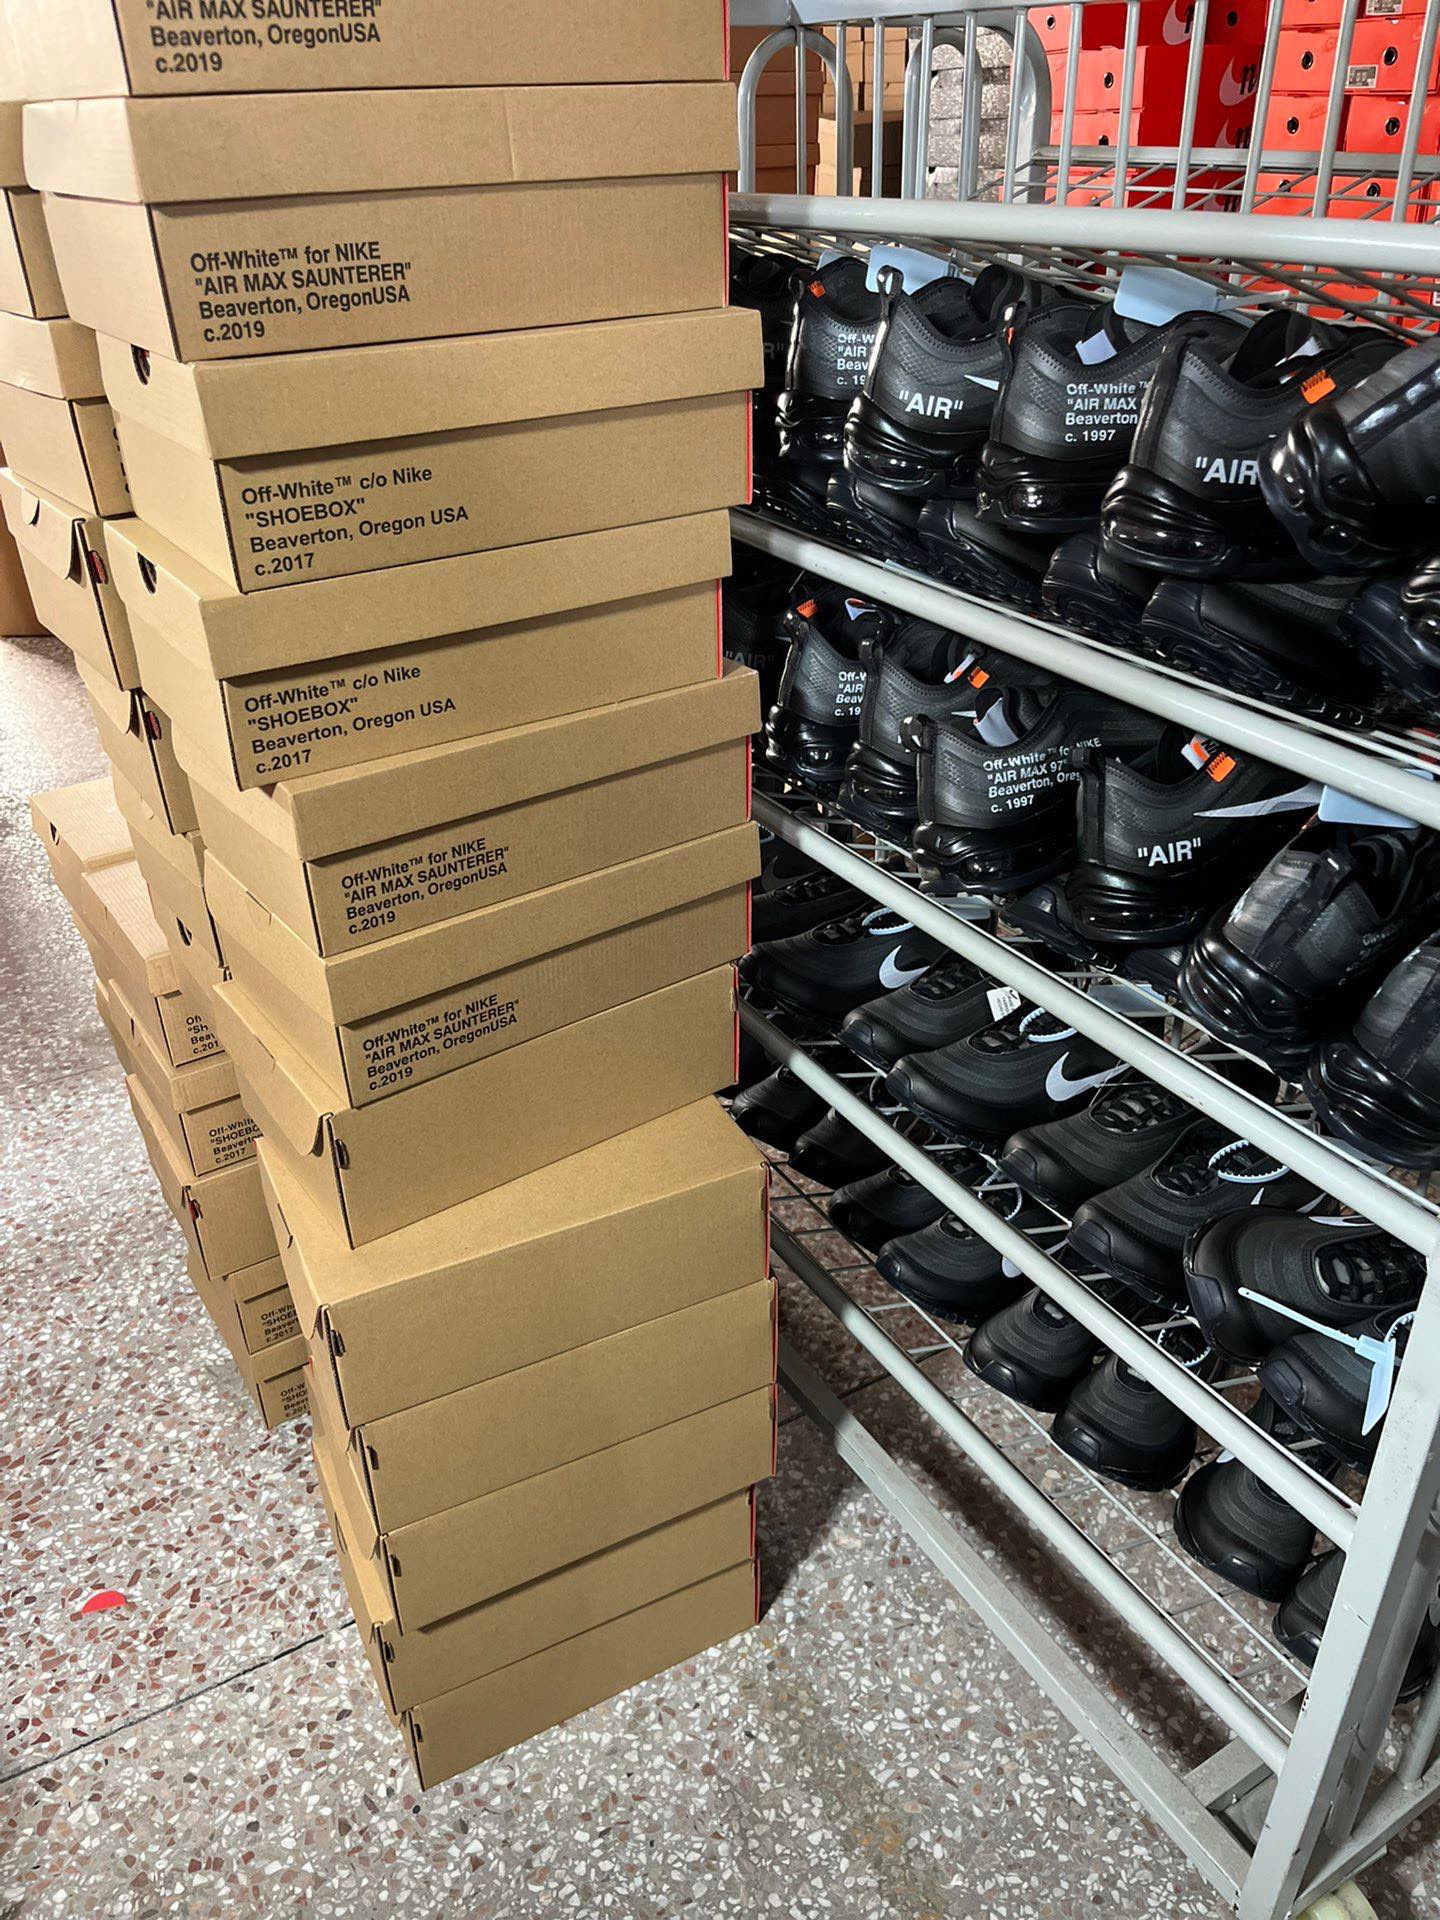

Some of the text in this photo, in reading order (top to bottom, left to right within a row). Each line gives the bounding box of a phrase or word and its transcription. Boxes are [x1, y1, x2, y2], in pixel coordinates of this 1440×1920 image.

[147, 0, 193, 20] "AIR
[200, 0, 247, 19] MAX
[150, 22, 381, 49] Beaverton, OregonUSA
[155, 52, 223, 73] c.2019
[190, 241, 381, 273] Off-White™ for NIKE
[195, 262, 412, 296] "AIR MAX SAUNTERER"
[199, 284, 410, 320] Beaverton, OregonUSA
[203, 320, 265, 342] c.2019
[837, 377, 848, 385] c.
[899, 390, 964, 420] "AIR"
[1065, 412, 1138, 425] Beaverton
[1067, 397, 1137, 411] "AIR MAX
[1065, 429, 1116, 442] c. 1997
[1195, 456, 1259, 485] "AIR
[241, 467, 432, 505] Off-White™ c/o Nike
[245, 498, 365, 528] "SHOEBOX"
[250, 506, 469, 553] Beaverton, Oregon USA
[254, 552, 314, 576] c.2017
[244, 667, 421, 713] Off-White™ c/o Nike
[248, 697, 358, 731] "SHOEBOX"
[252, 698, 456, 754] Beaverton, Oregon USA
[256, 749, 312, 774] c.2017
[987, 770, 1017, 785] "AIR
[1020, 763, 1048, 779] MAX
[988, 776, 1054, 799] Beaverton,
[990, 794, 1035, 813] c. 1997
[342, 838, 487, 889] Off-White™ for NIKE
[1137, 837, 1201, 867] "AIR"
[344, 846, 509, 903] "AIR MAX SAUNTERER"
[346, 862, 508, 920] Beaverton, OregonUSA
[349, 911, 396, 935] c.2019
[363, 994, 498, 1051] Off-White™ for NIKE
[365, 999, 519, 1063] "AIR MAX SAUNTERER"
[367, 1014, 517, 1078] Beaverton, OregonUSA
[369, 1067, 413, 1090] c.2019
